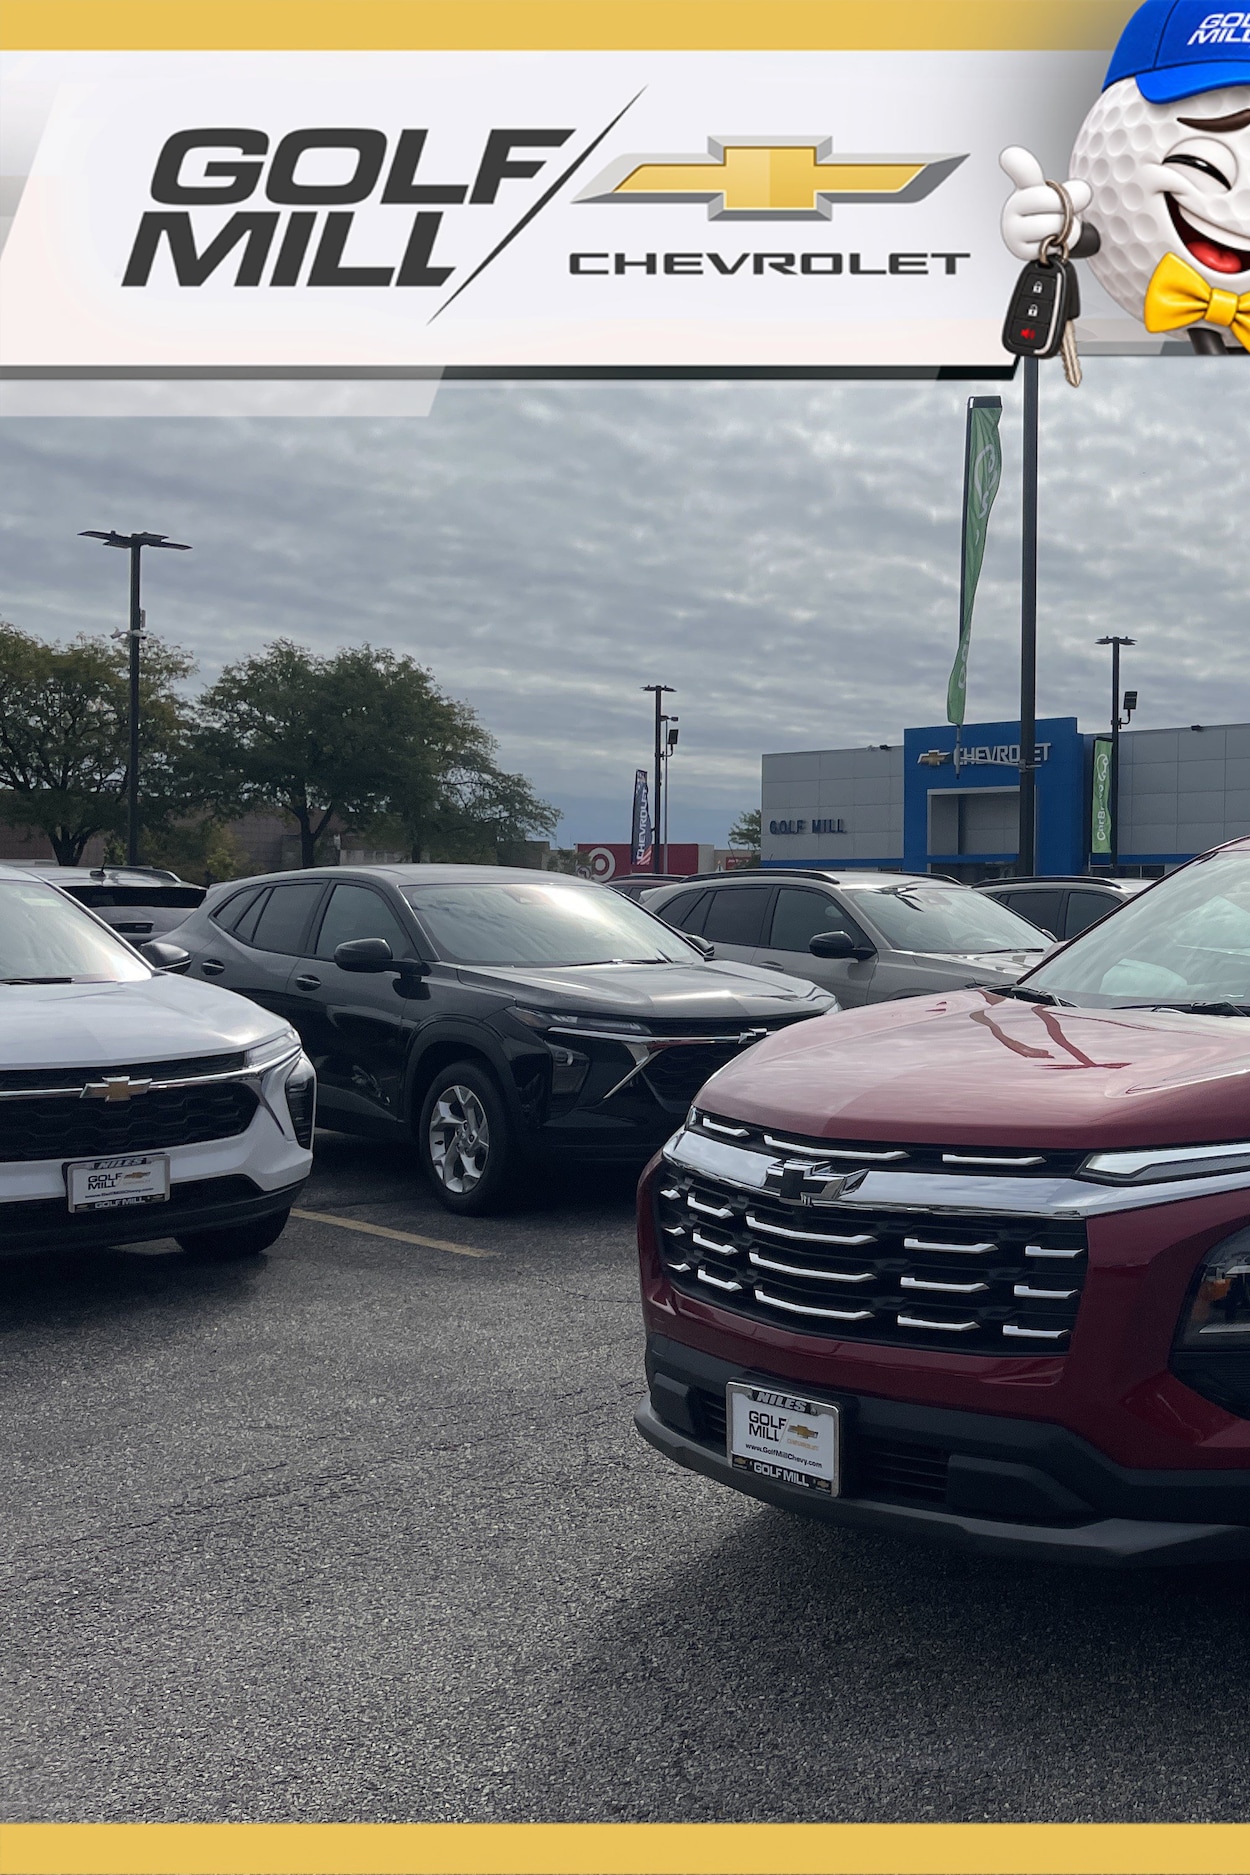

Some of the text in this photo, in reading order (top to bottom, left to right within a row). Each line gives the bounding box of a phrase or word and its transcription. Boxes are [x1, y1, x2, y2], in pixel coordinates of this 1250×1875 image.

[953, 742, 1052, 766] CHEVROET
[769, 818, 847, 835] GOLF MILL
[88, 1172, 123, 1183] GOLF
[88, 1180, 116, 1190] MILL
[95, 1196, 147, 1209] GOLF MILL
[756, 1391, 807, 1413] NILES
[748, 1410, 787, 1430] GOLF
[748, 1422, 780, 1442] MILL
[753, 1461, 810, 1488] GOLF MILL
